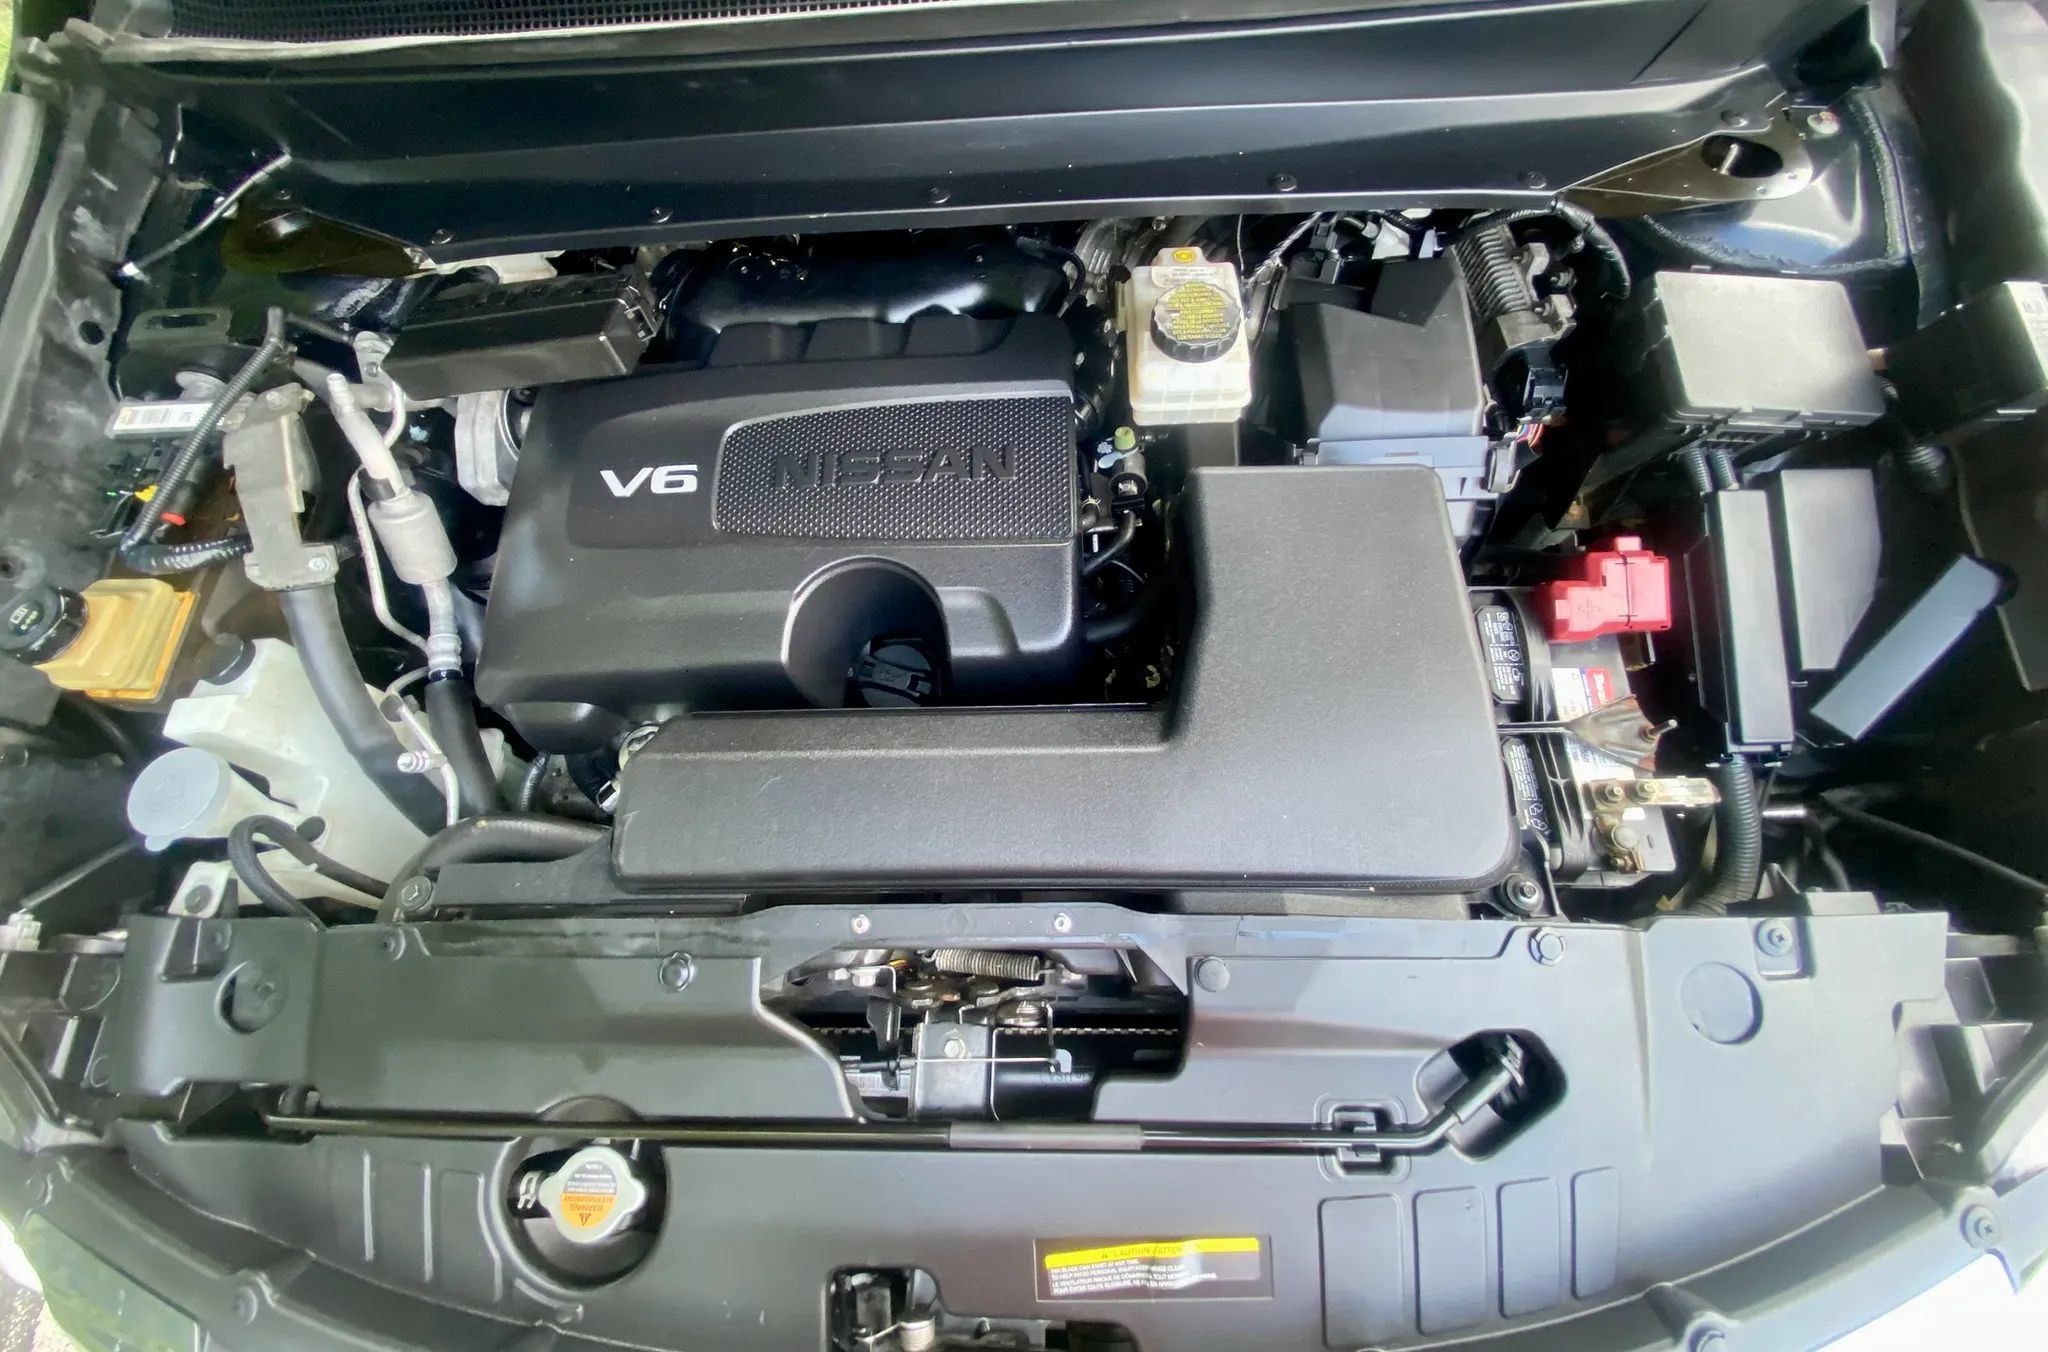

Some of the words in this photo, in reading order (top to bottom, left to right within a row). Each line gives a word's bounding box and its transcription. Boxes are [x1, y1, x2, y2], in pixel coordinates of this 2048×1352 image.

[600, 464, 698, 497] V6
[774, 444, 1018, 489] NISSAN
[569, 1203, 603, 1212] WARNING
